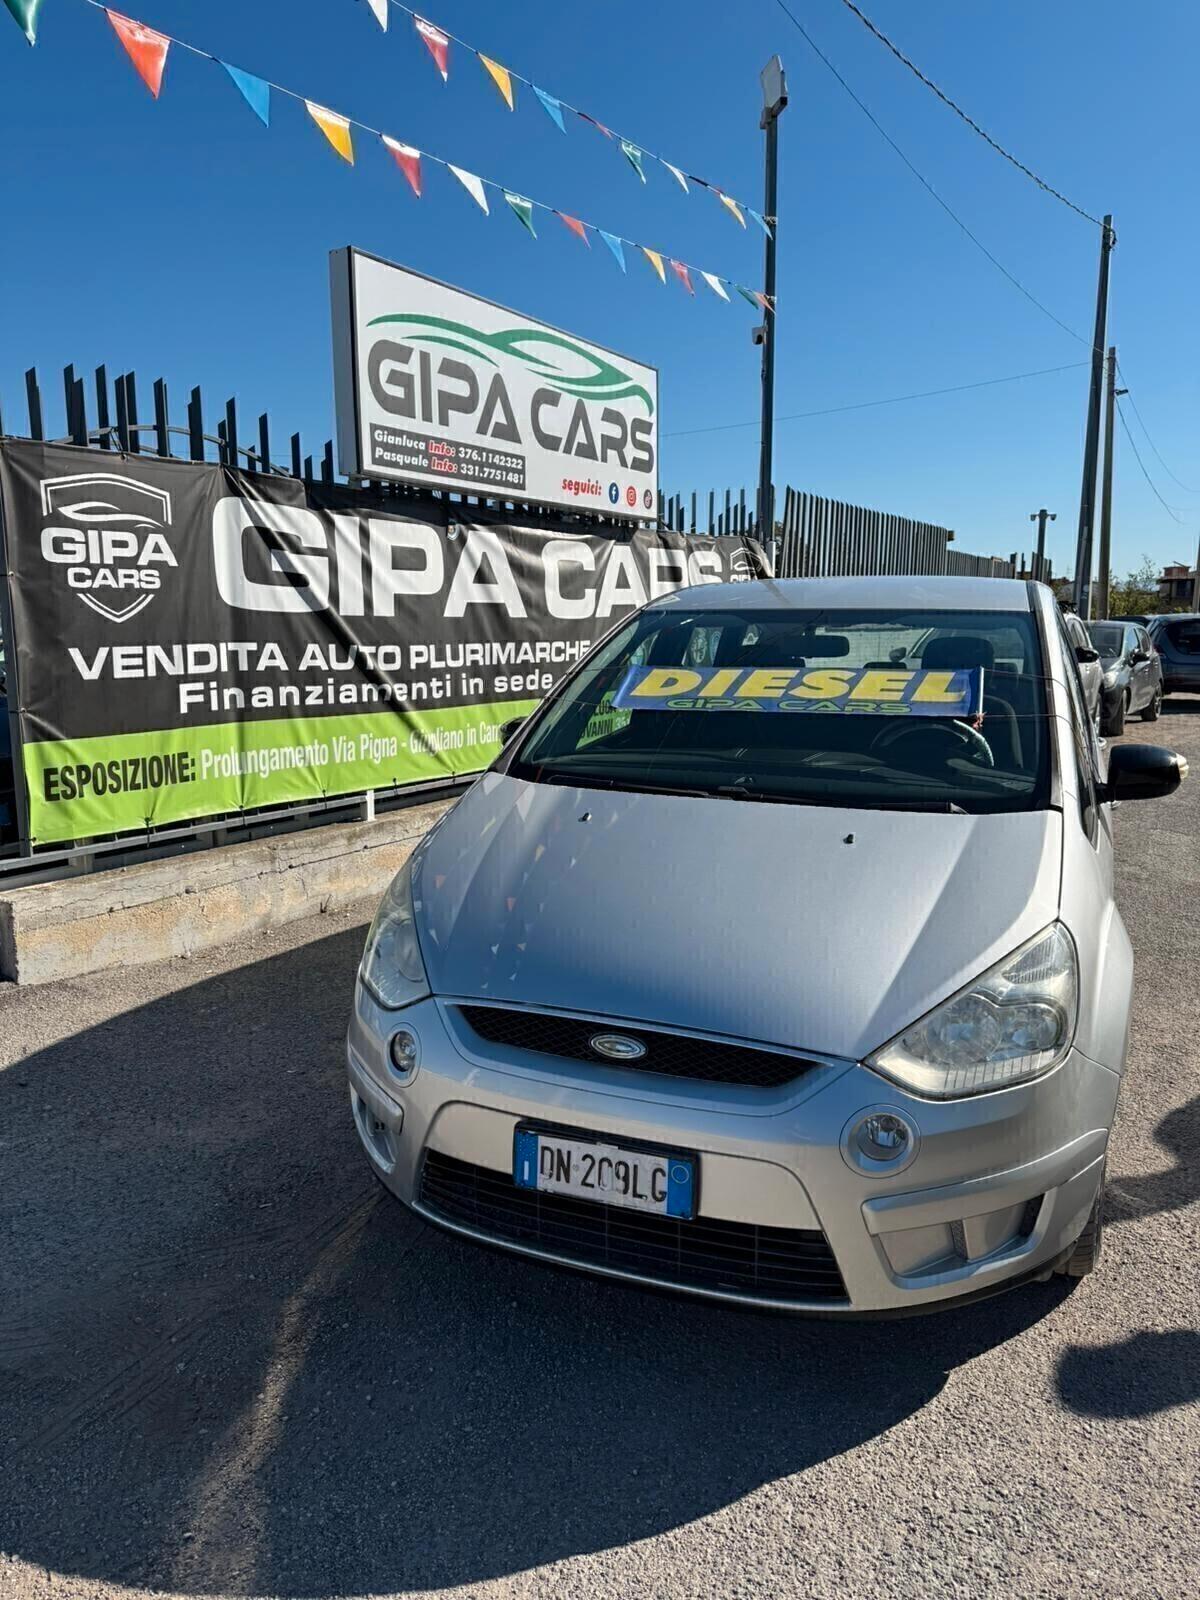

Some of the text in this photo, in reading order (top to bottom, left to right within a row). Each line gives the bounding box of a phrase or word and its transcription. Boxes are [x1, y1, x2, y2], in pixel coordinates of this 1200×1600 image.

[368, 339, 654, 474] GIPA CARS
[374, 429, 523, 470] Gianluca Info: 376.1142322
[375, 447, 523, 484] Pasquale Info: 331.7751481
[562, 478, 602, 496] seguici:
[40, 527, 179, 567] GIPA
[212, 496, 528, 618] GIPA
[67, 567, 161, 589] CARS
[68, 642, 289, 680] VENDITA
[298, 642, 402, 671] AUTO
[179, 669, 553, 714] Finanziamenti in sede
[631, 668, 967, 703] DIESEL
[666, 698, 912, 713] GIPA CARS
[43, 751, 197, 802] ESPOSIZIONE:
[201, 739, 329, 780] Prolungamento
[332, 735, 356, 763] Via
[360, 732, 398, 764] Pigna
[467, 723, 477, 746] in
[540, 1145, 571, 1183] DN
